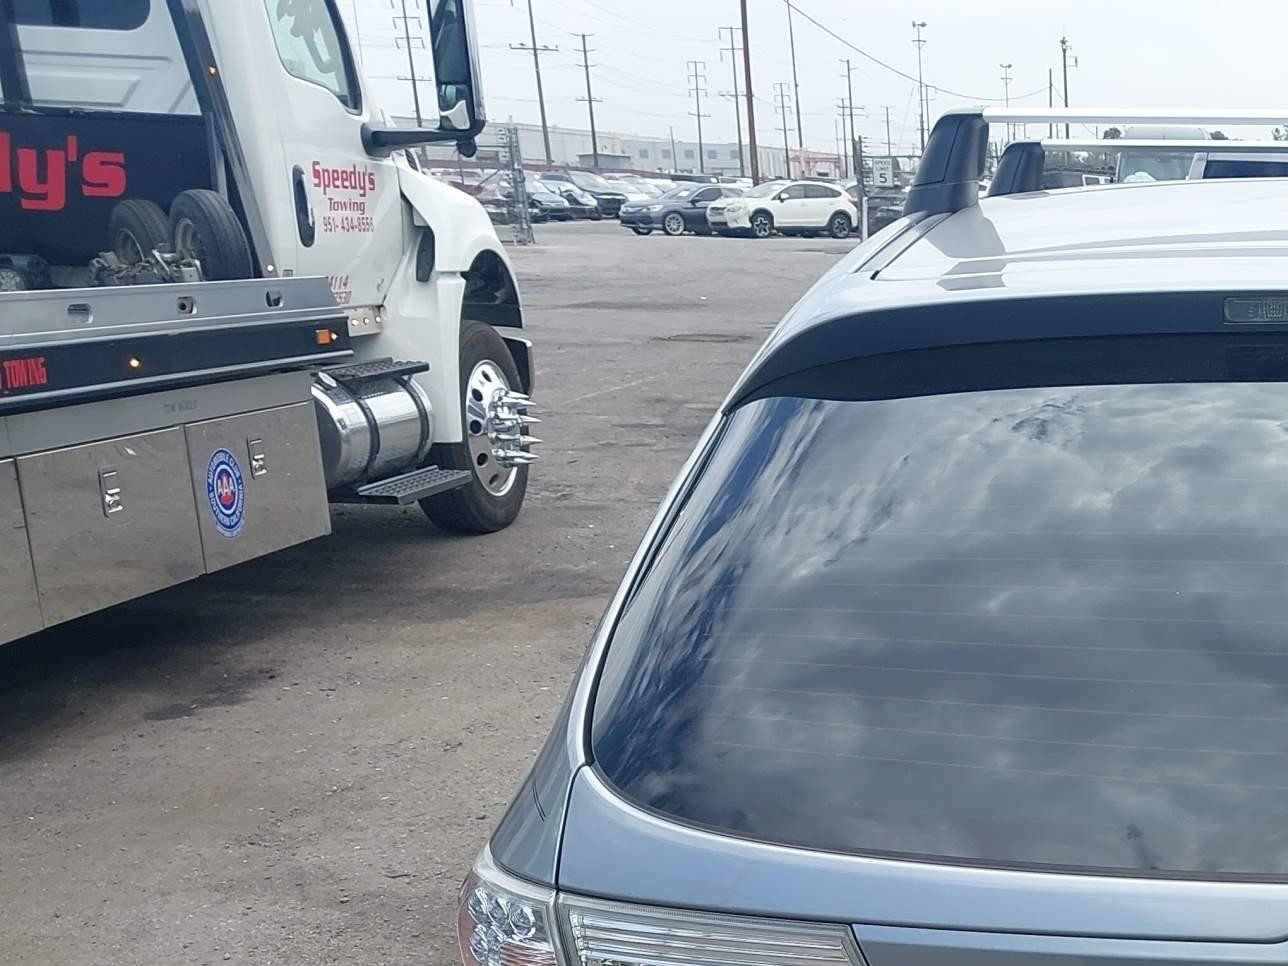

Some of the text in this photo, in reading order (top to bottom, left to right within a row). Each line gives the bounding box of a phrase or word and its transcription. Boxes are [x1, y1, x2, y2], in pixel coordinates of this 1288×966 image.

[312, 160, 376, 197] Speedy's
[879, 173, 887, 183] 5
[328, 198, 366, 216] Towing
[3, 357, 47, 388] TOWING
[217, 475, 236, 497] AAA
